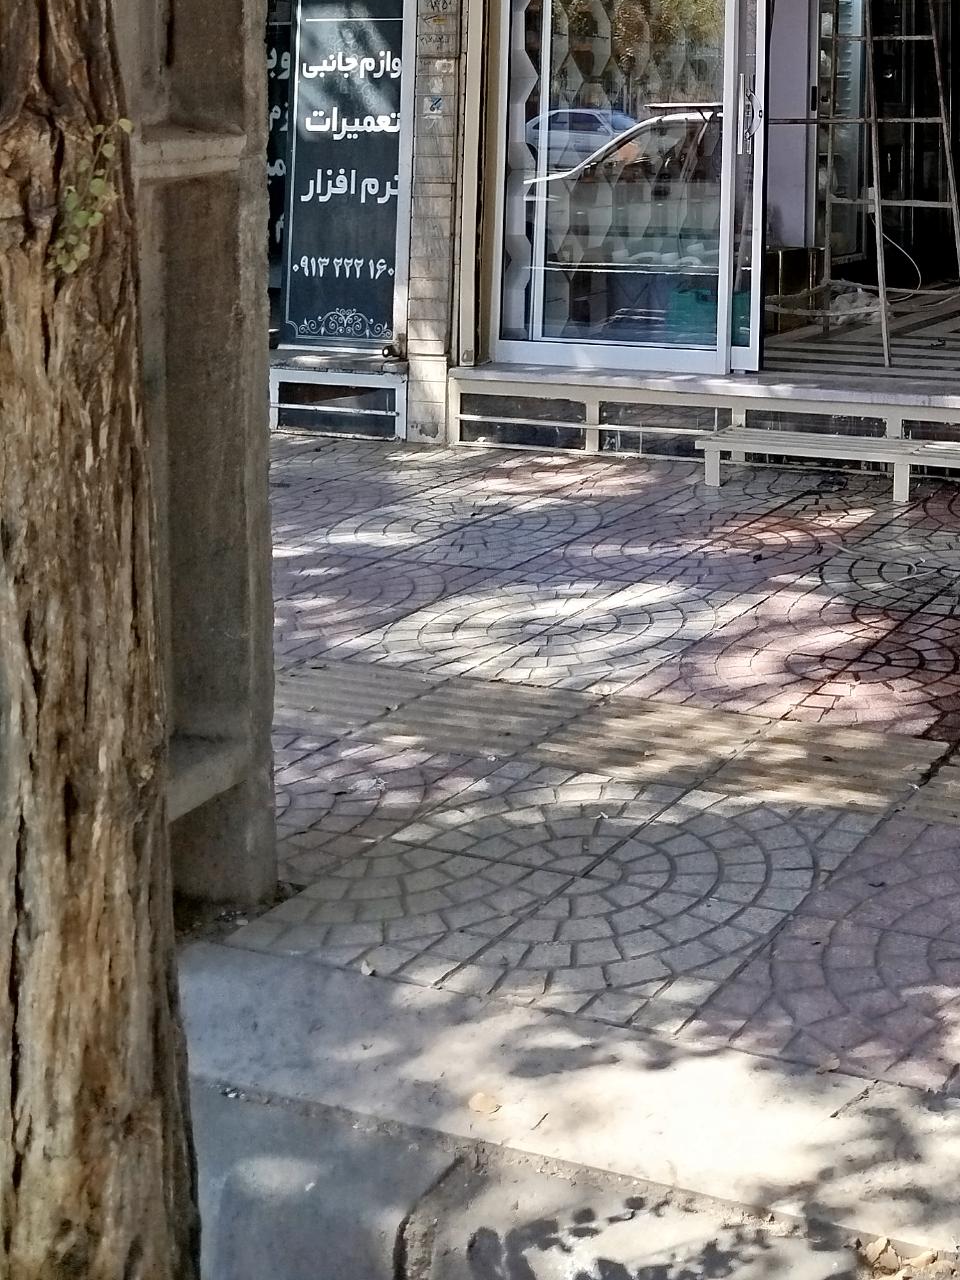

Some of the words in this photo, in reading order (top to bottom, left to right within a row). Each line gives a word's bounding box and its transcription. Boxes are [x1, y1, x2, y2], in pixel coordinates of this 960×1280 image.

[302, 51, 359, 79] جانبی
[360, 50, 402, 78] وازم
[305, 107, 400, 140] تعمیرات
[301, 168, 356, 202] افزار
[369, 258, 395, 280] ۱۶۰
